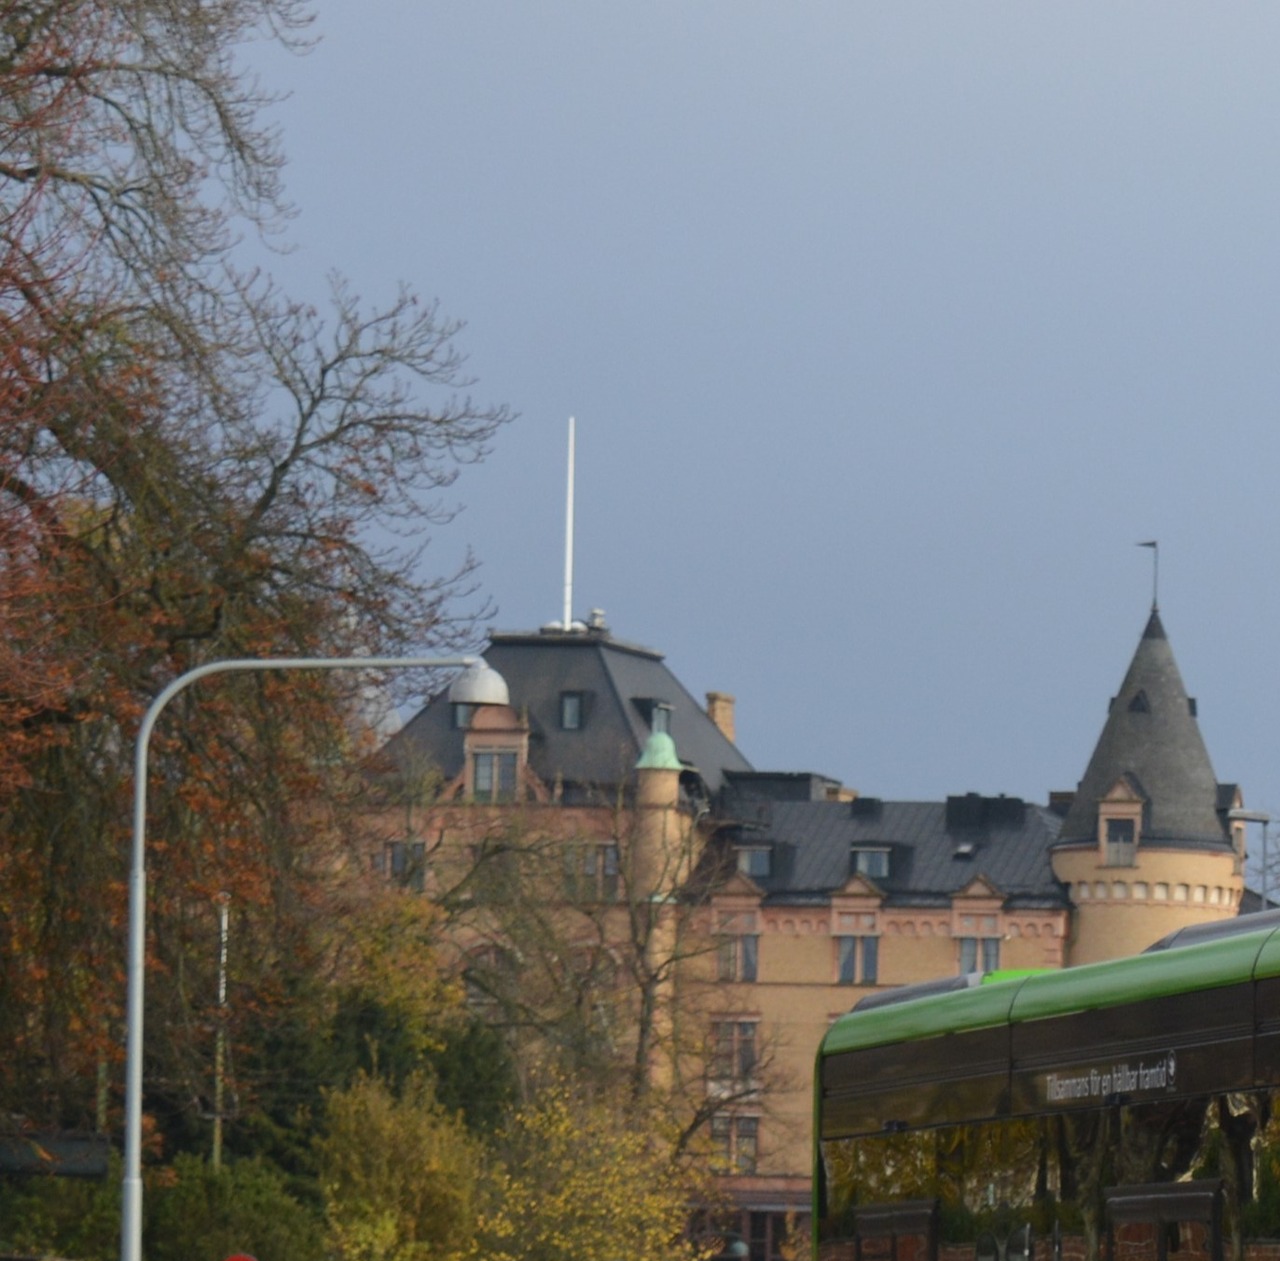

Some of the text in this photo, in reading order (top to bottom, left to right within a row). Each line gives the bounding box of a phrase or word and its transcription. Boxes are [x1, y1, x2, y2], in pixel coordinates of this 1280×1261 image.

[1090, 1069, 1101, 1096] för
[1102, 1073, 1111, 1096] en
[1139, 1059, 1167, 1090] framtid
